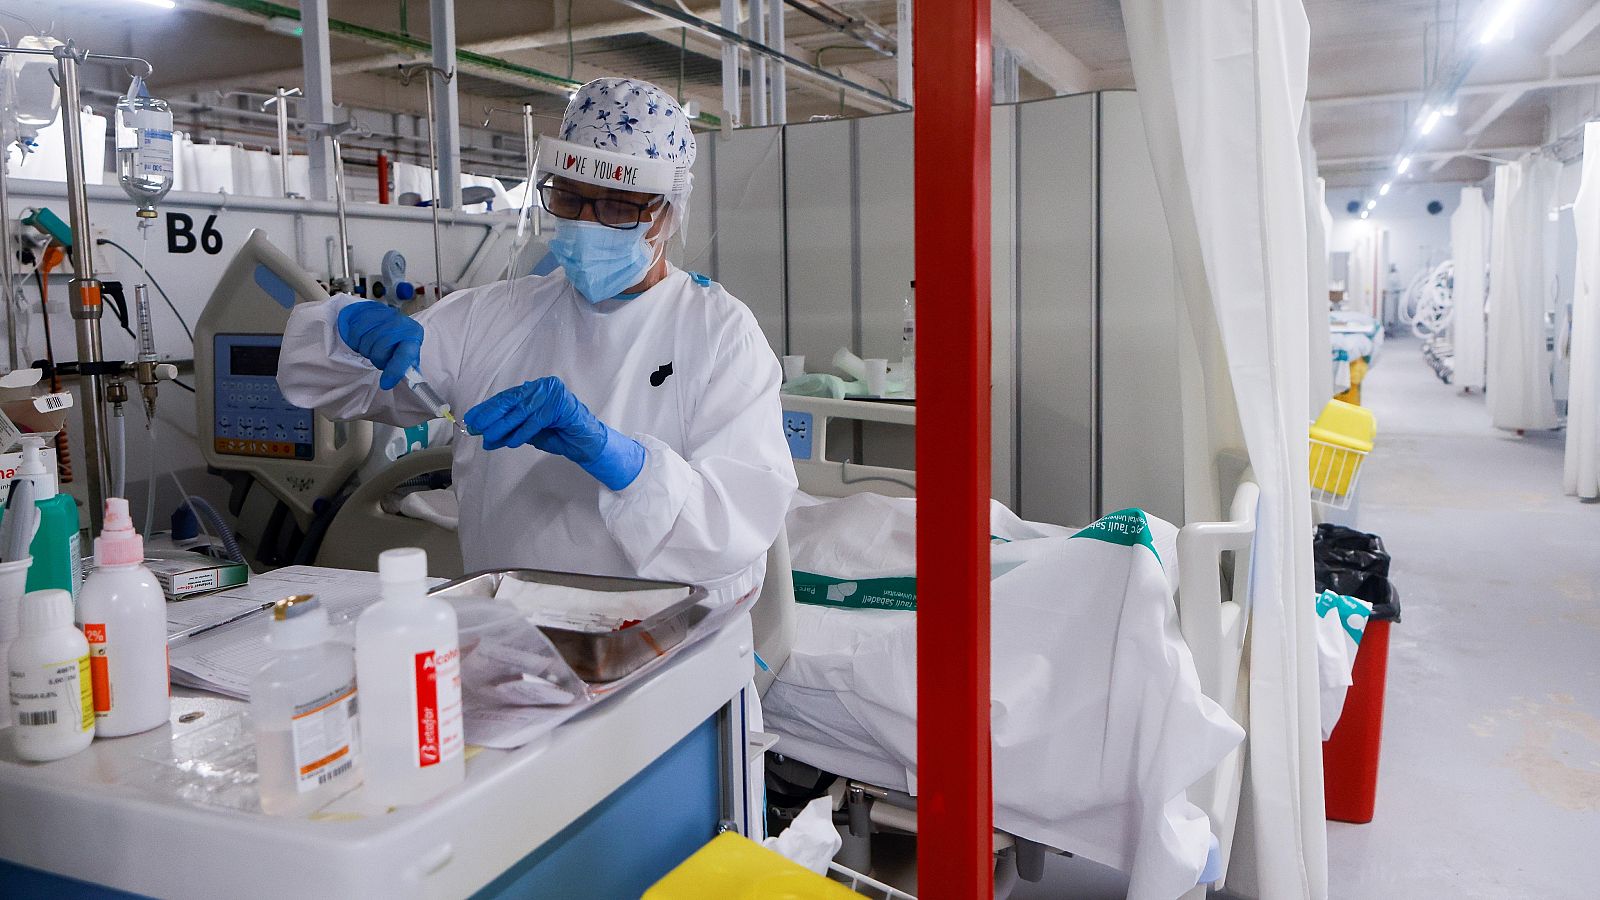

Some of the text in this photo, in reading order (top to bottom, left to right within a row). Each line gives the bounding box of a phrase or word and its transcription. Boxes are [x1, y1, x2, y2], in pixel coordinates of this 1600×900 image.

[555, 151, 559, 167] I
[166, 212, 223, 254] B6
[862, 594, 895, 606] Sabadell
